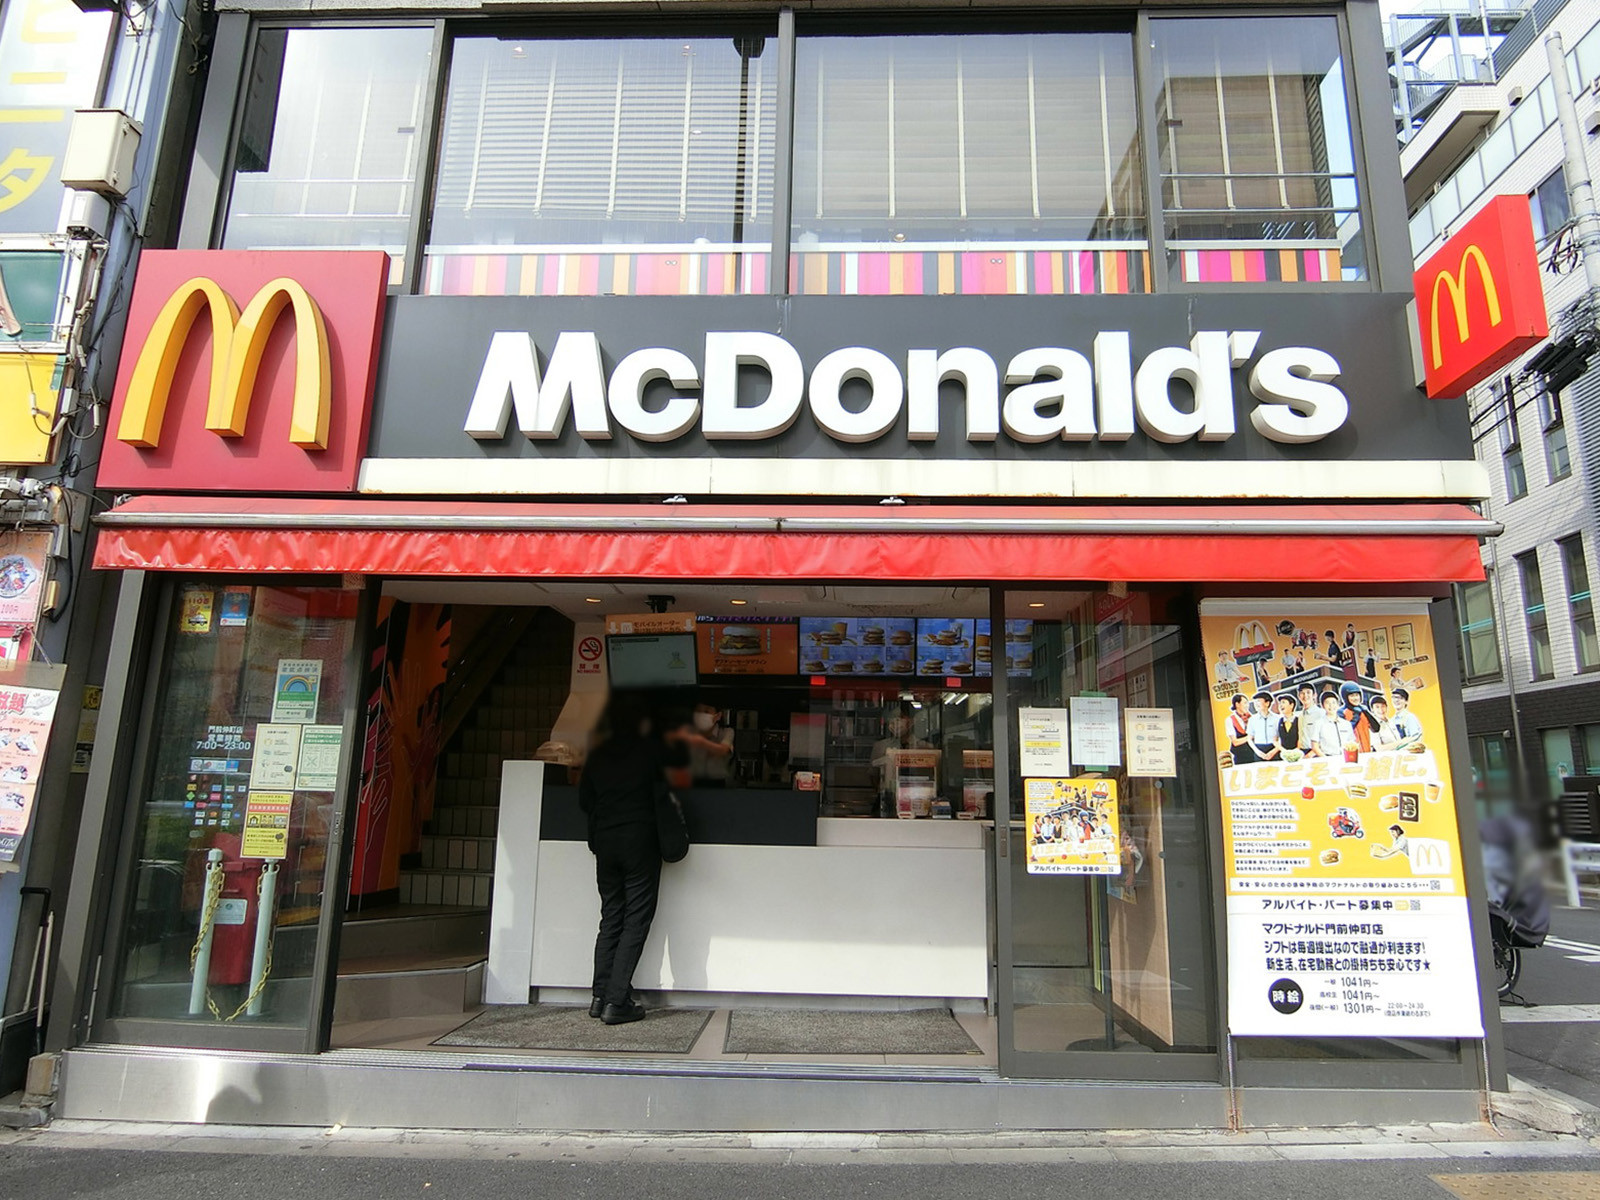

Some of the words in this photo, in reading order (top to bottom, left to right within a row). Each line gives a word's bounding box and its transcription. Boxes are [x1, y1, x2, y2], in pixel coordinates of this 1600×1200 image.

[463, 330, 1349, 443] McDonald's
[1262, 923, 1384, 936] マクドナルド門前仲町店
[1272, 990, 1300, 1004] 時給
